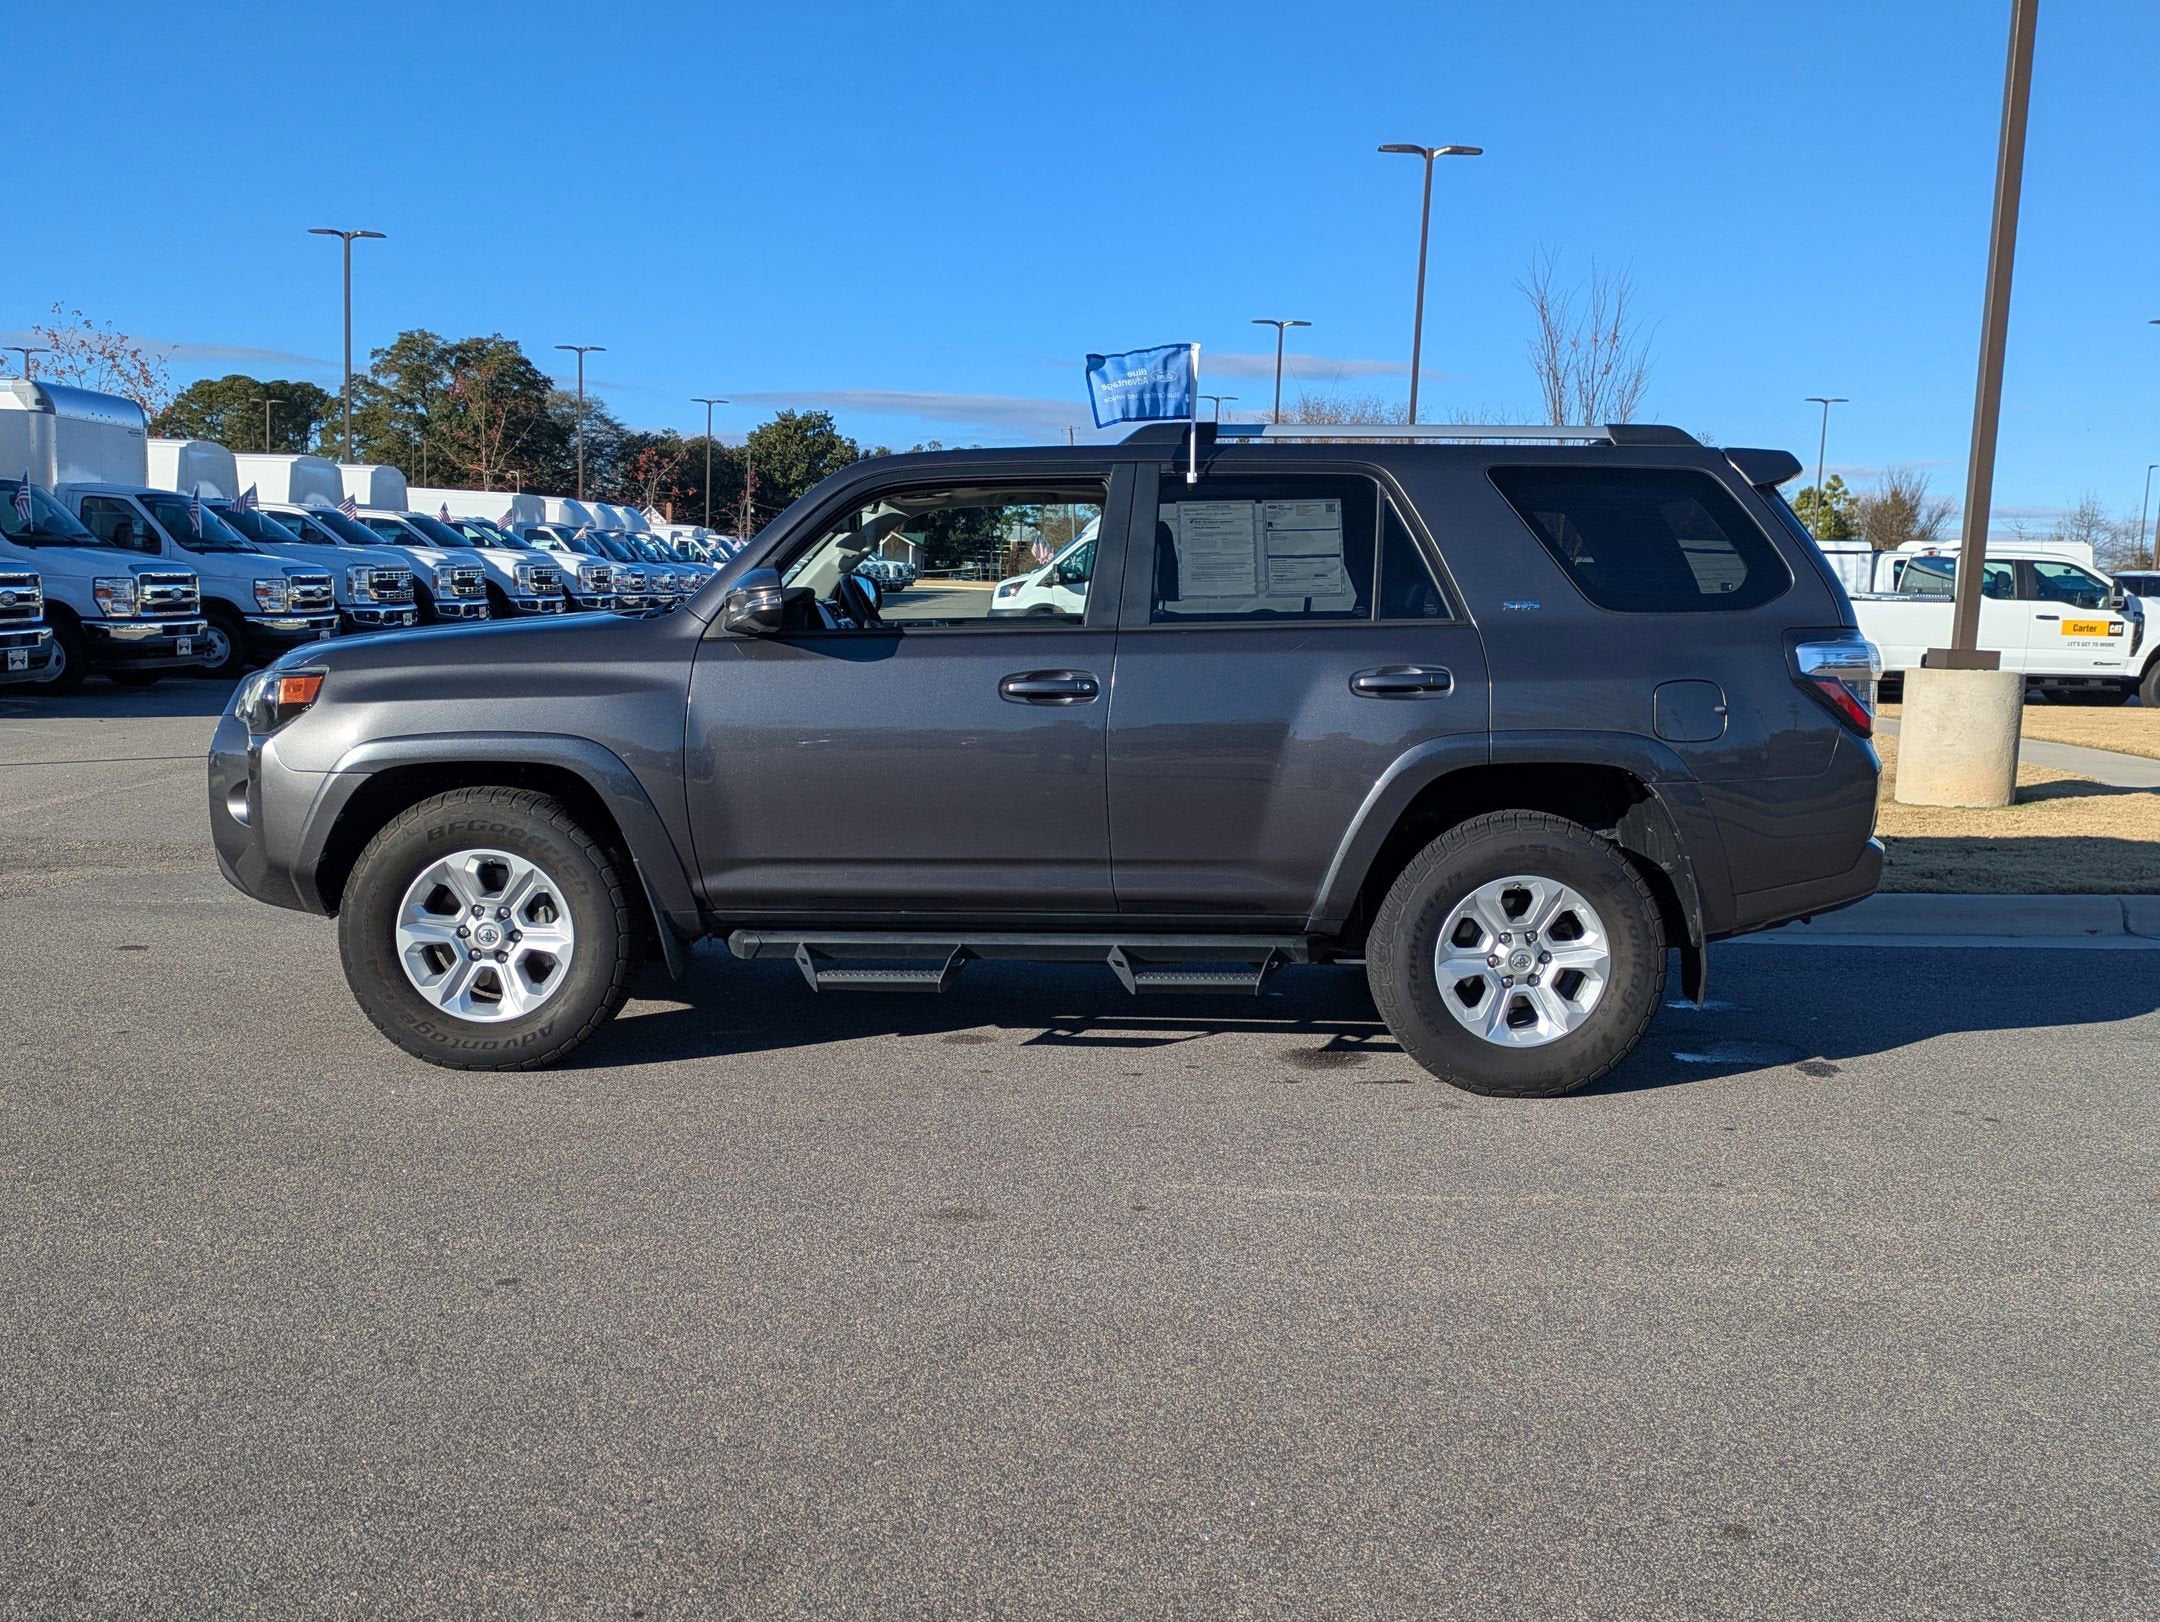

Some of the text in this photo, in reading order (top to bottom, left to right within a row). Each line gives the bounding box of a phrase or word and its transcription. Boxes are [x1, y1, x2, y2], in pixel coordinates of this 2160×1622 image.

[2073, 624, 2097, 633] Carter
[2109, 624, 2123, 633] CAT
[427, 819, 591, 895] BFGoodrich
[399, 1012, 555, 1050] Advantage
